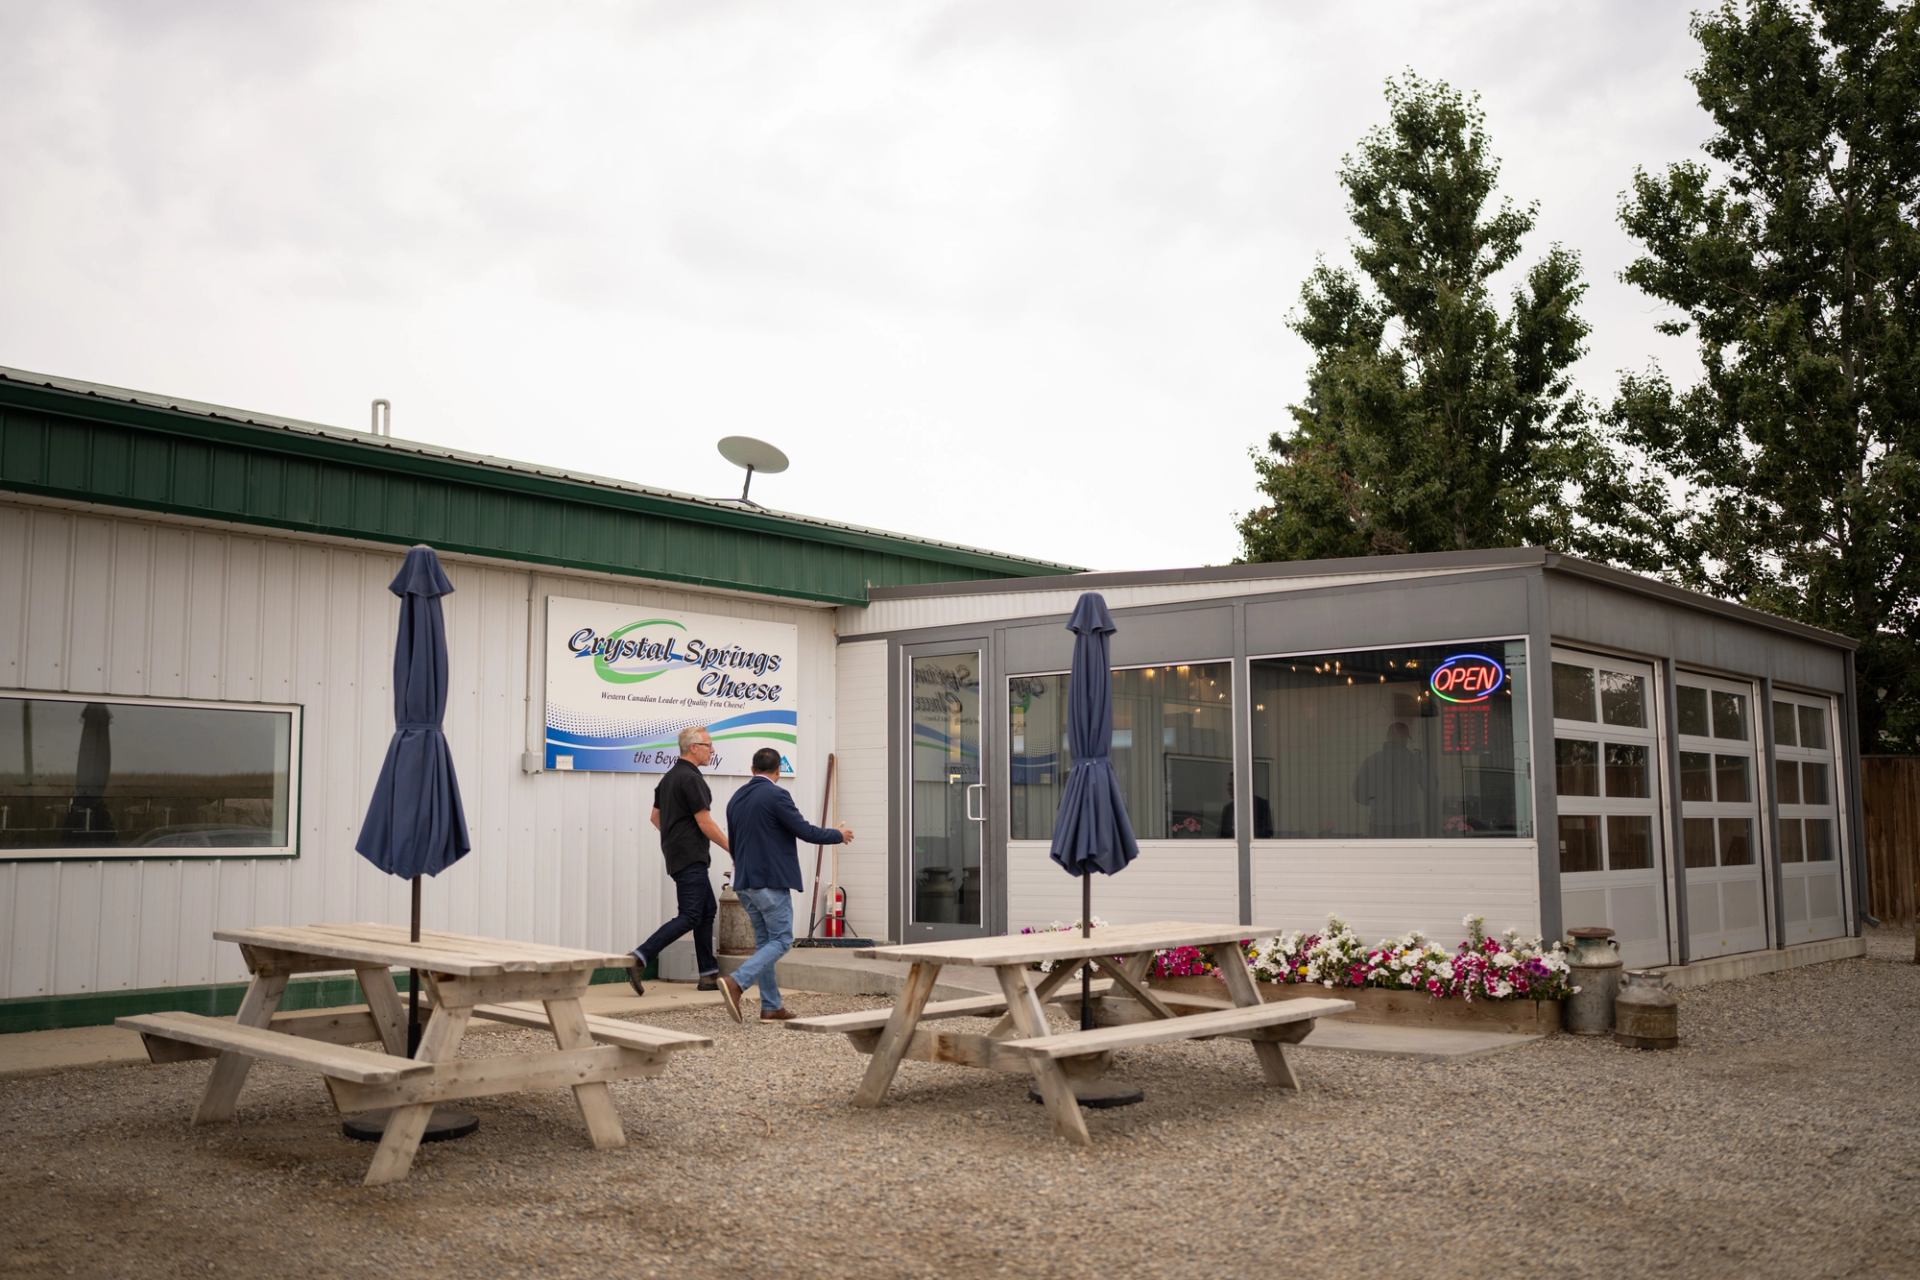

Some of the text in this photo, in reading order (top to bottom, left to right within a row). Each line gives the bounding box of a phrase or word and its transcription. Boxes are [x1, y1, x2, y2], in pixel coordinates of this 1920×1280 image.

[567, 628, 782, 677] Crystal Springs
[696, 672, 782, 701] Cheese
[1434, 666, 1497, 691] OPEN
[601, 691, 746, 710] Western Canadian Leader of Quality Feta Cheese!
[633, 751, 652, 764] the
[654, 750, 680, 769] Beye
